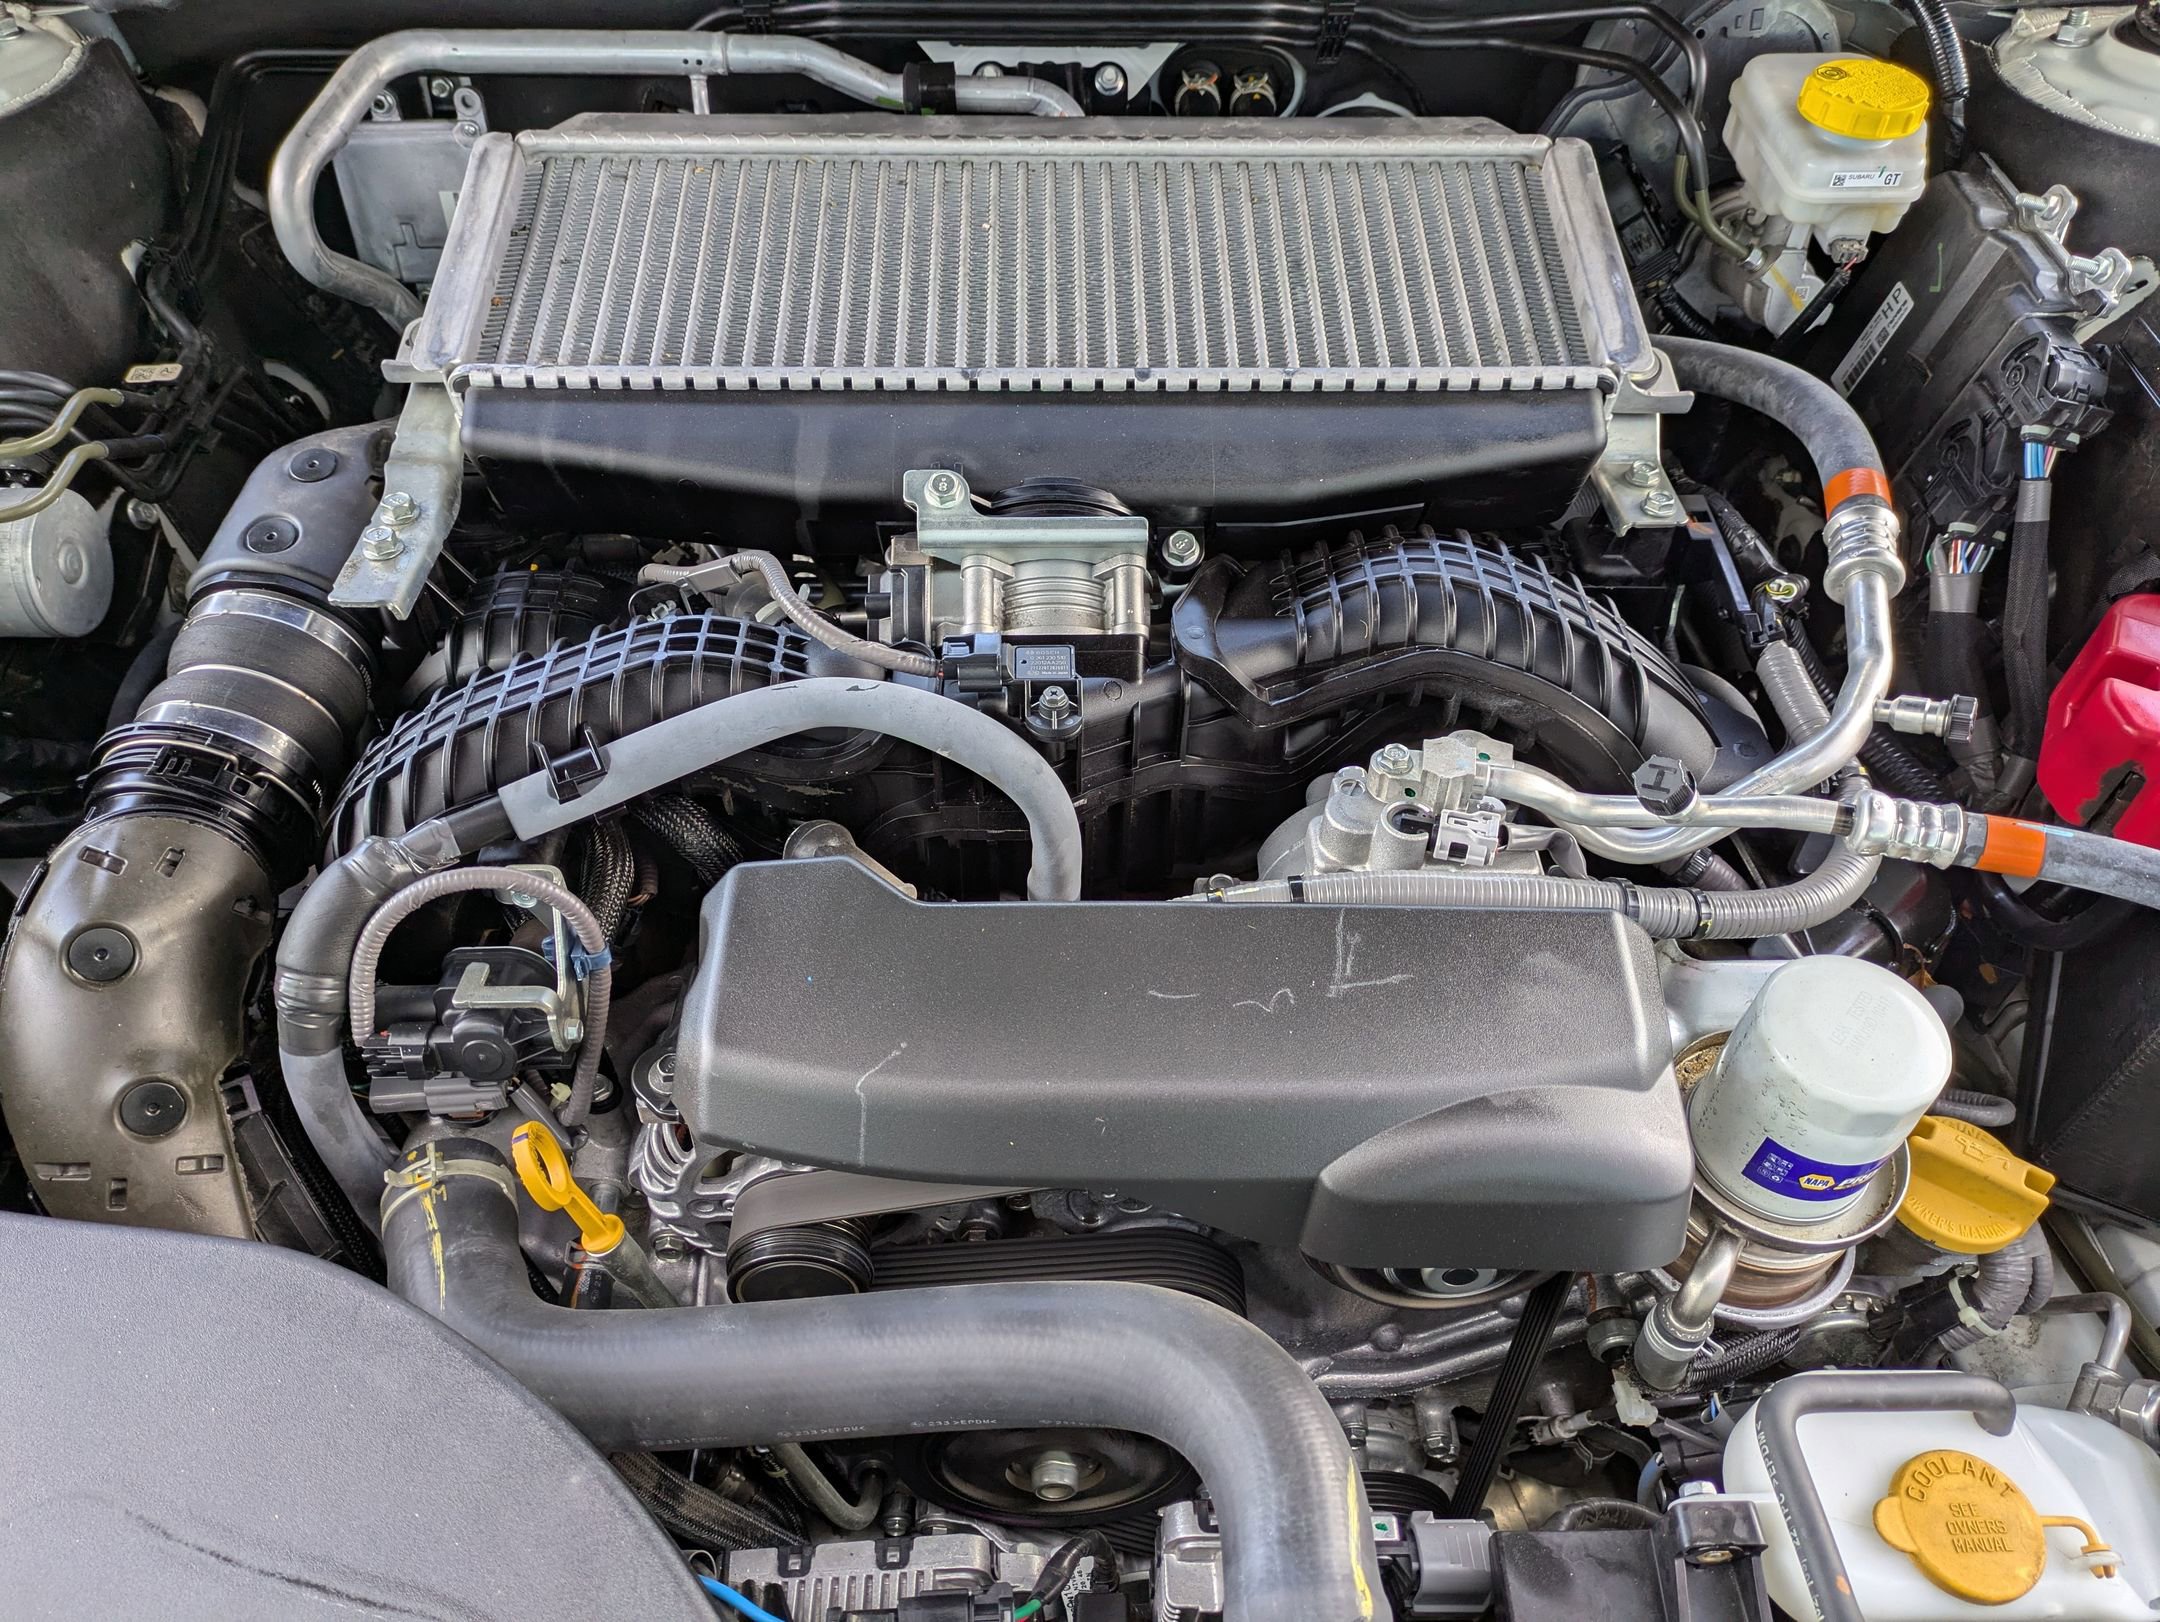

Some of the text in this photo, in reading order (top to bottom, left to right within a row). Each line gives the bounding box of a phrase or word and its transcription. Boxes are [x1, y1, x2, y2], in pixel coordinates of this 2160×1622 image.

[1884, 173, 1902, 186] GT
[1803, 1176, 1830, 1188] NAPA
[1906, 1196, 2009, 1240] OWNER'S MANUAL
[1906, 1457, 2016, 1502] COOLANT
[1949, 1503, 1980, 1518] SEE
[1952, 1537, 2014, 1553] MANUAL
